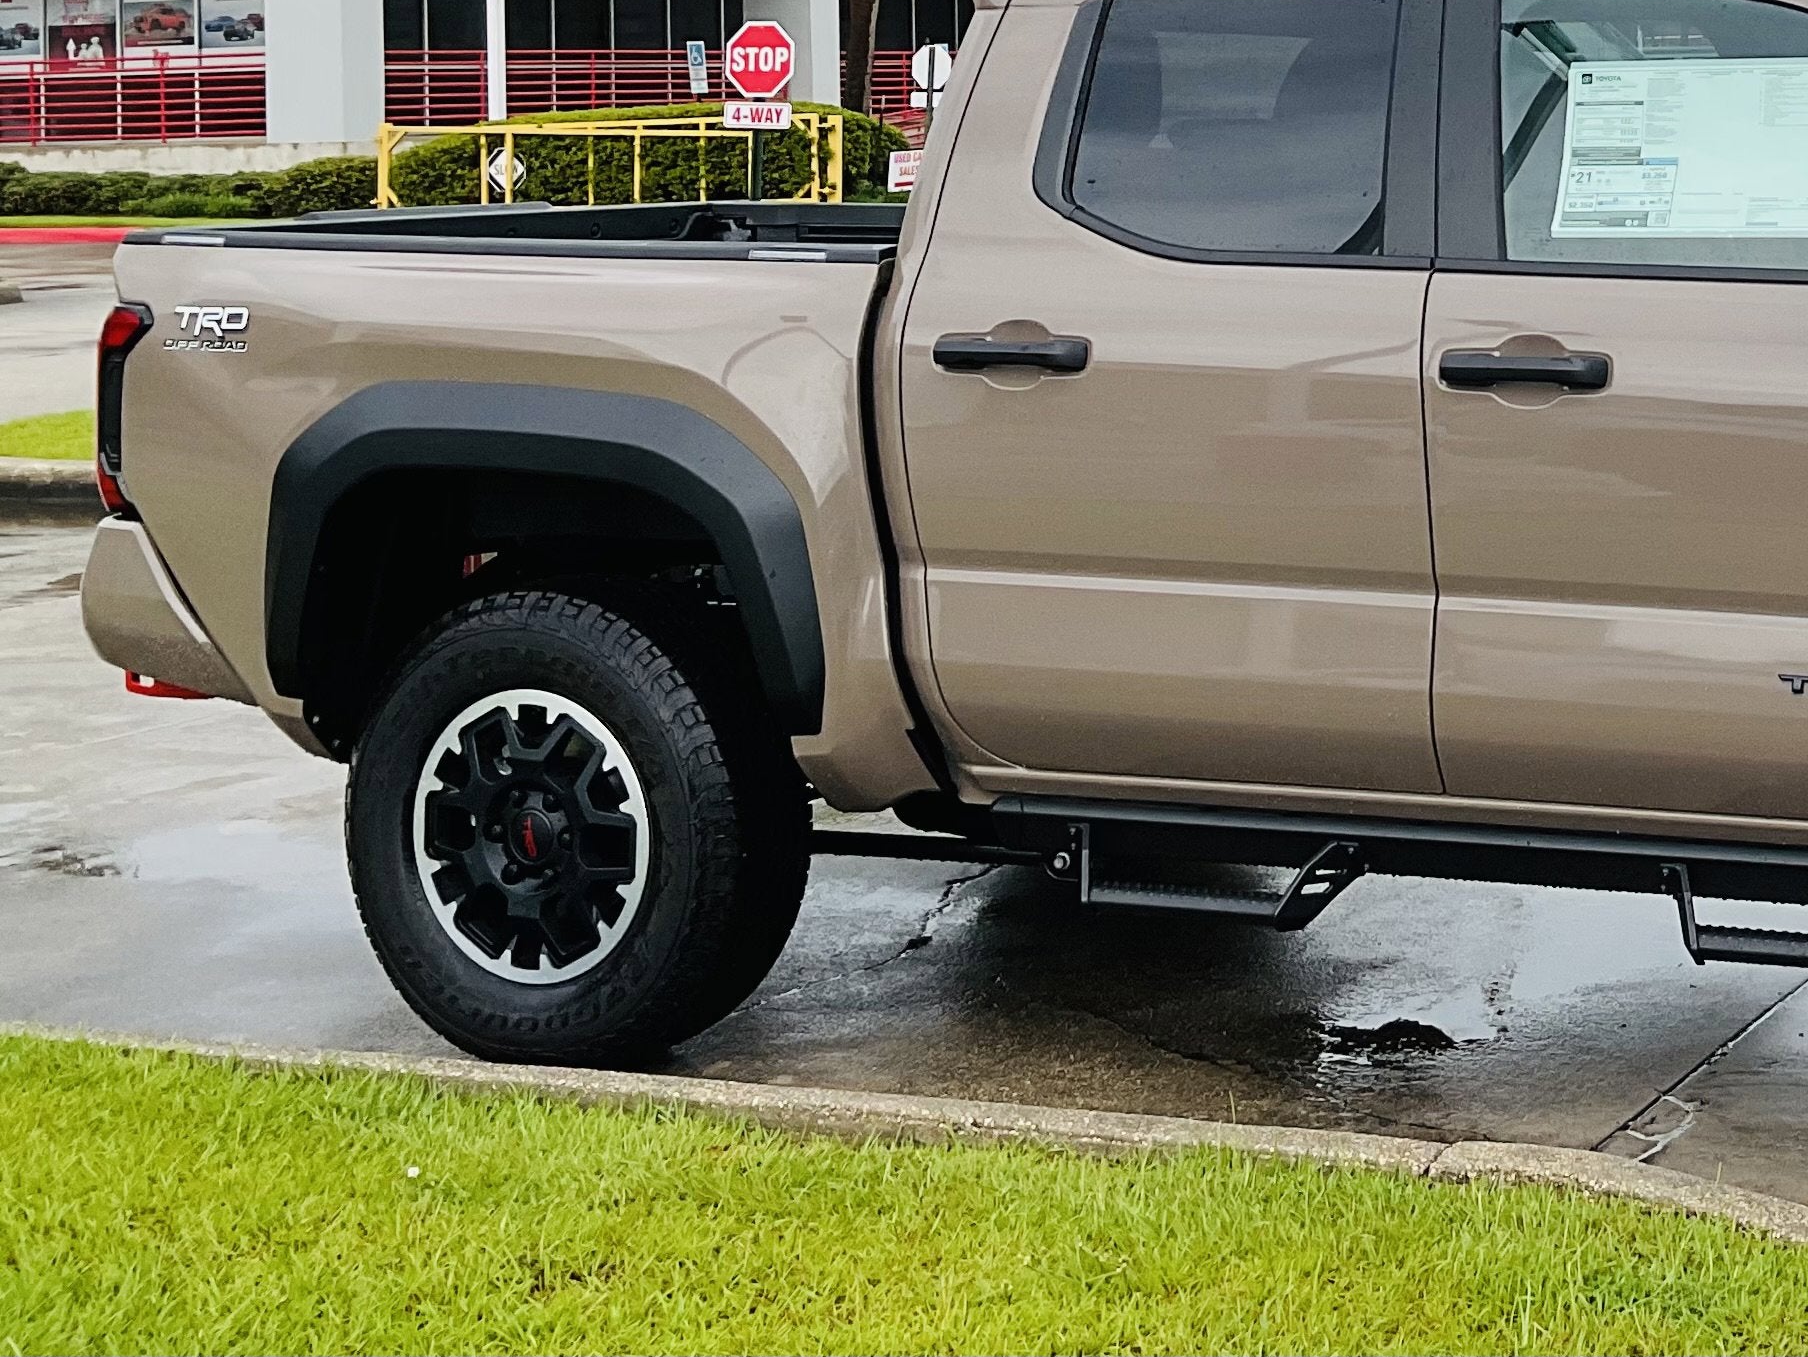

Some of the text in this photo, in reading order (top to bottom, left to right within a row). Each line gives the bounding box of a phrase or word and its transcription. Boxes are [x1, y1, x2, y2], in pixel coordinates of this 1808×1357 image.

[731, 46, 788, 72] STOP
[732, 106, 784, 124] 4-WAY
[894, 153, 912, 164] USED
[1575, 171, 1593, 184] 21
[174, 304, 250, 339] TRD
[162, 339, 249, 353] OFF ROAD
